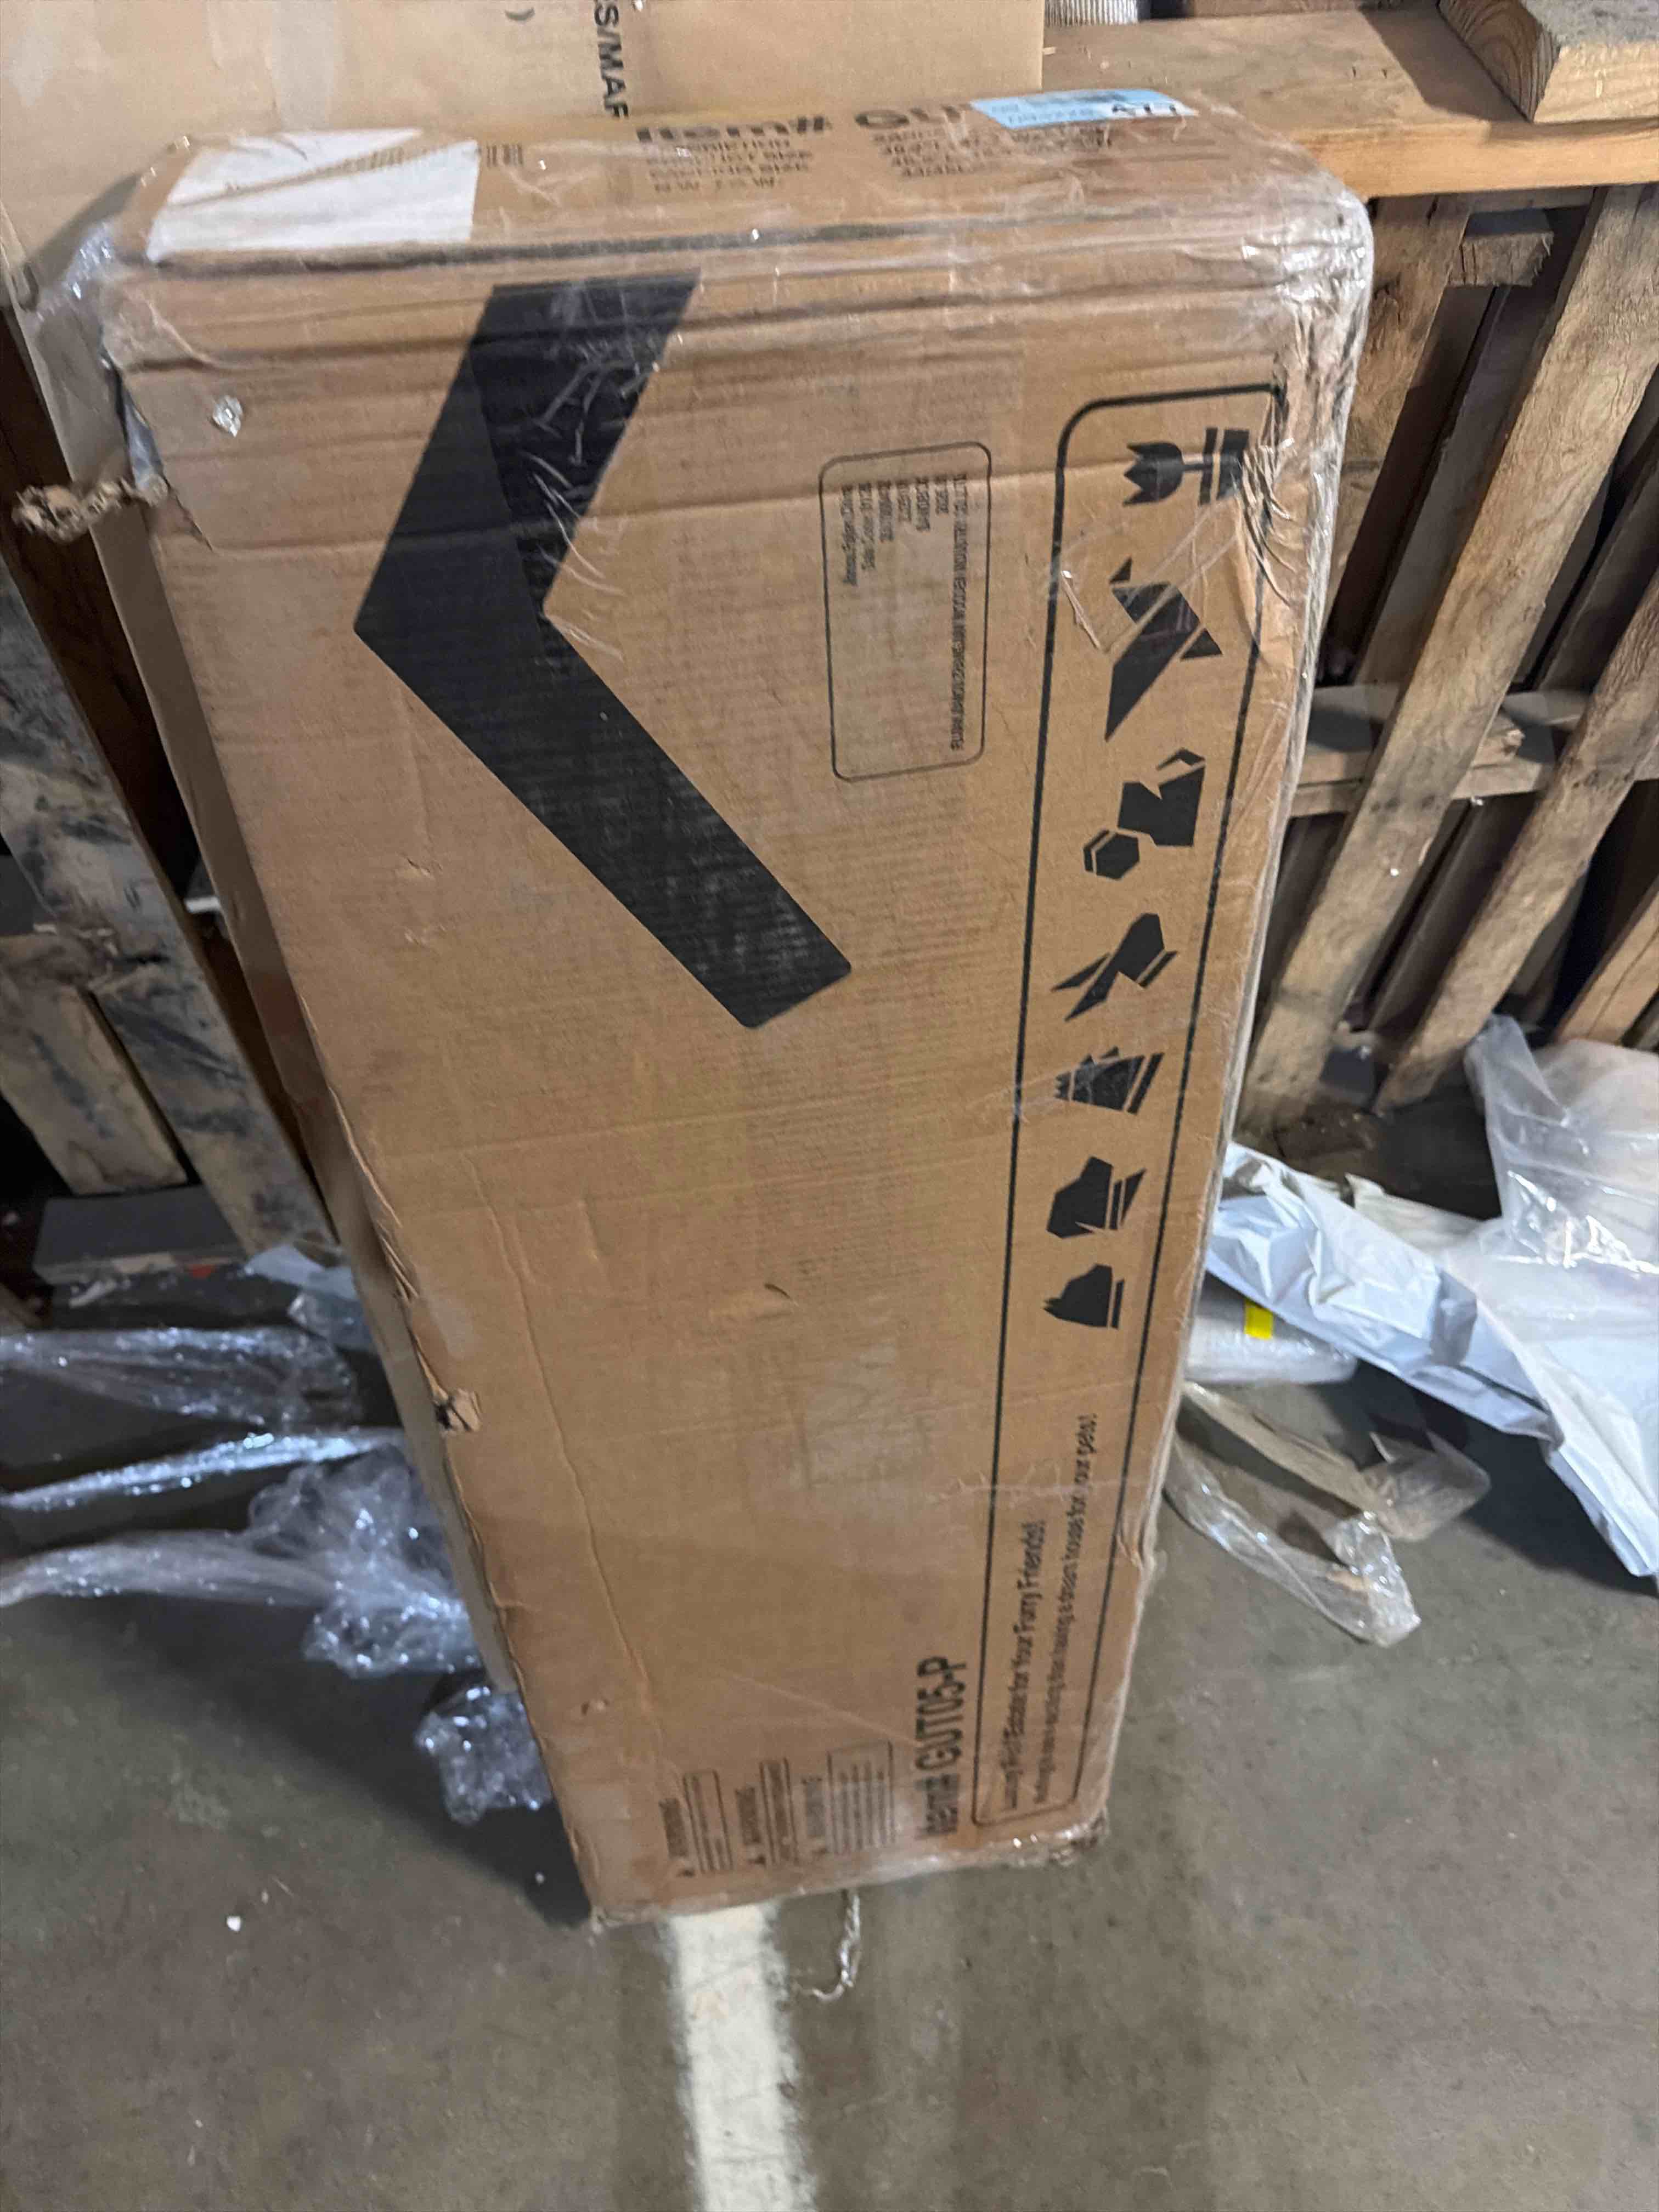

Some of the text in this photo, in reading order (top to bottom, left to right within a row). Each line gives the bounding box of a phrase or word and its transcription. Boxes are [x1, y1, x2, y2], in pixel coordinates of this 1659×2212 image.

[1076, 1413, 1097, 1454] pets!
[1017, 1519, 1045, 1590] Friends!
[1013, 1592, 1043, 1634] Furry
